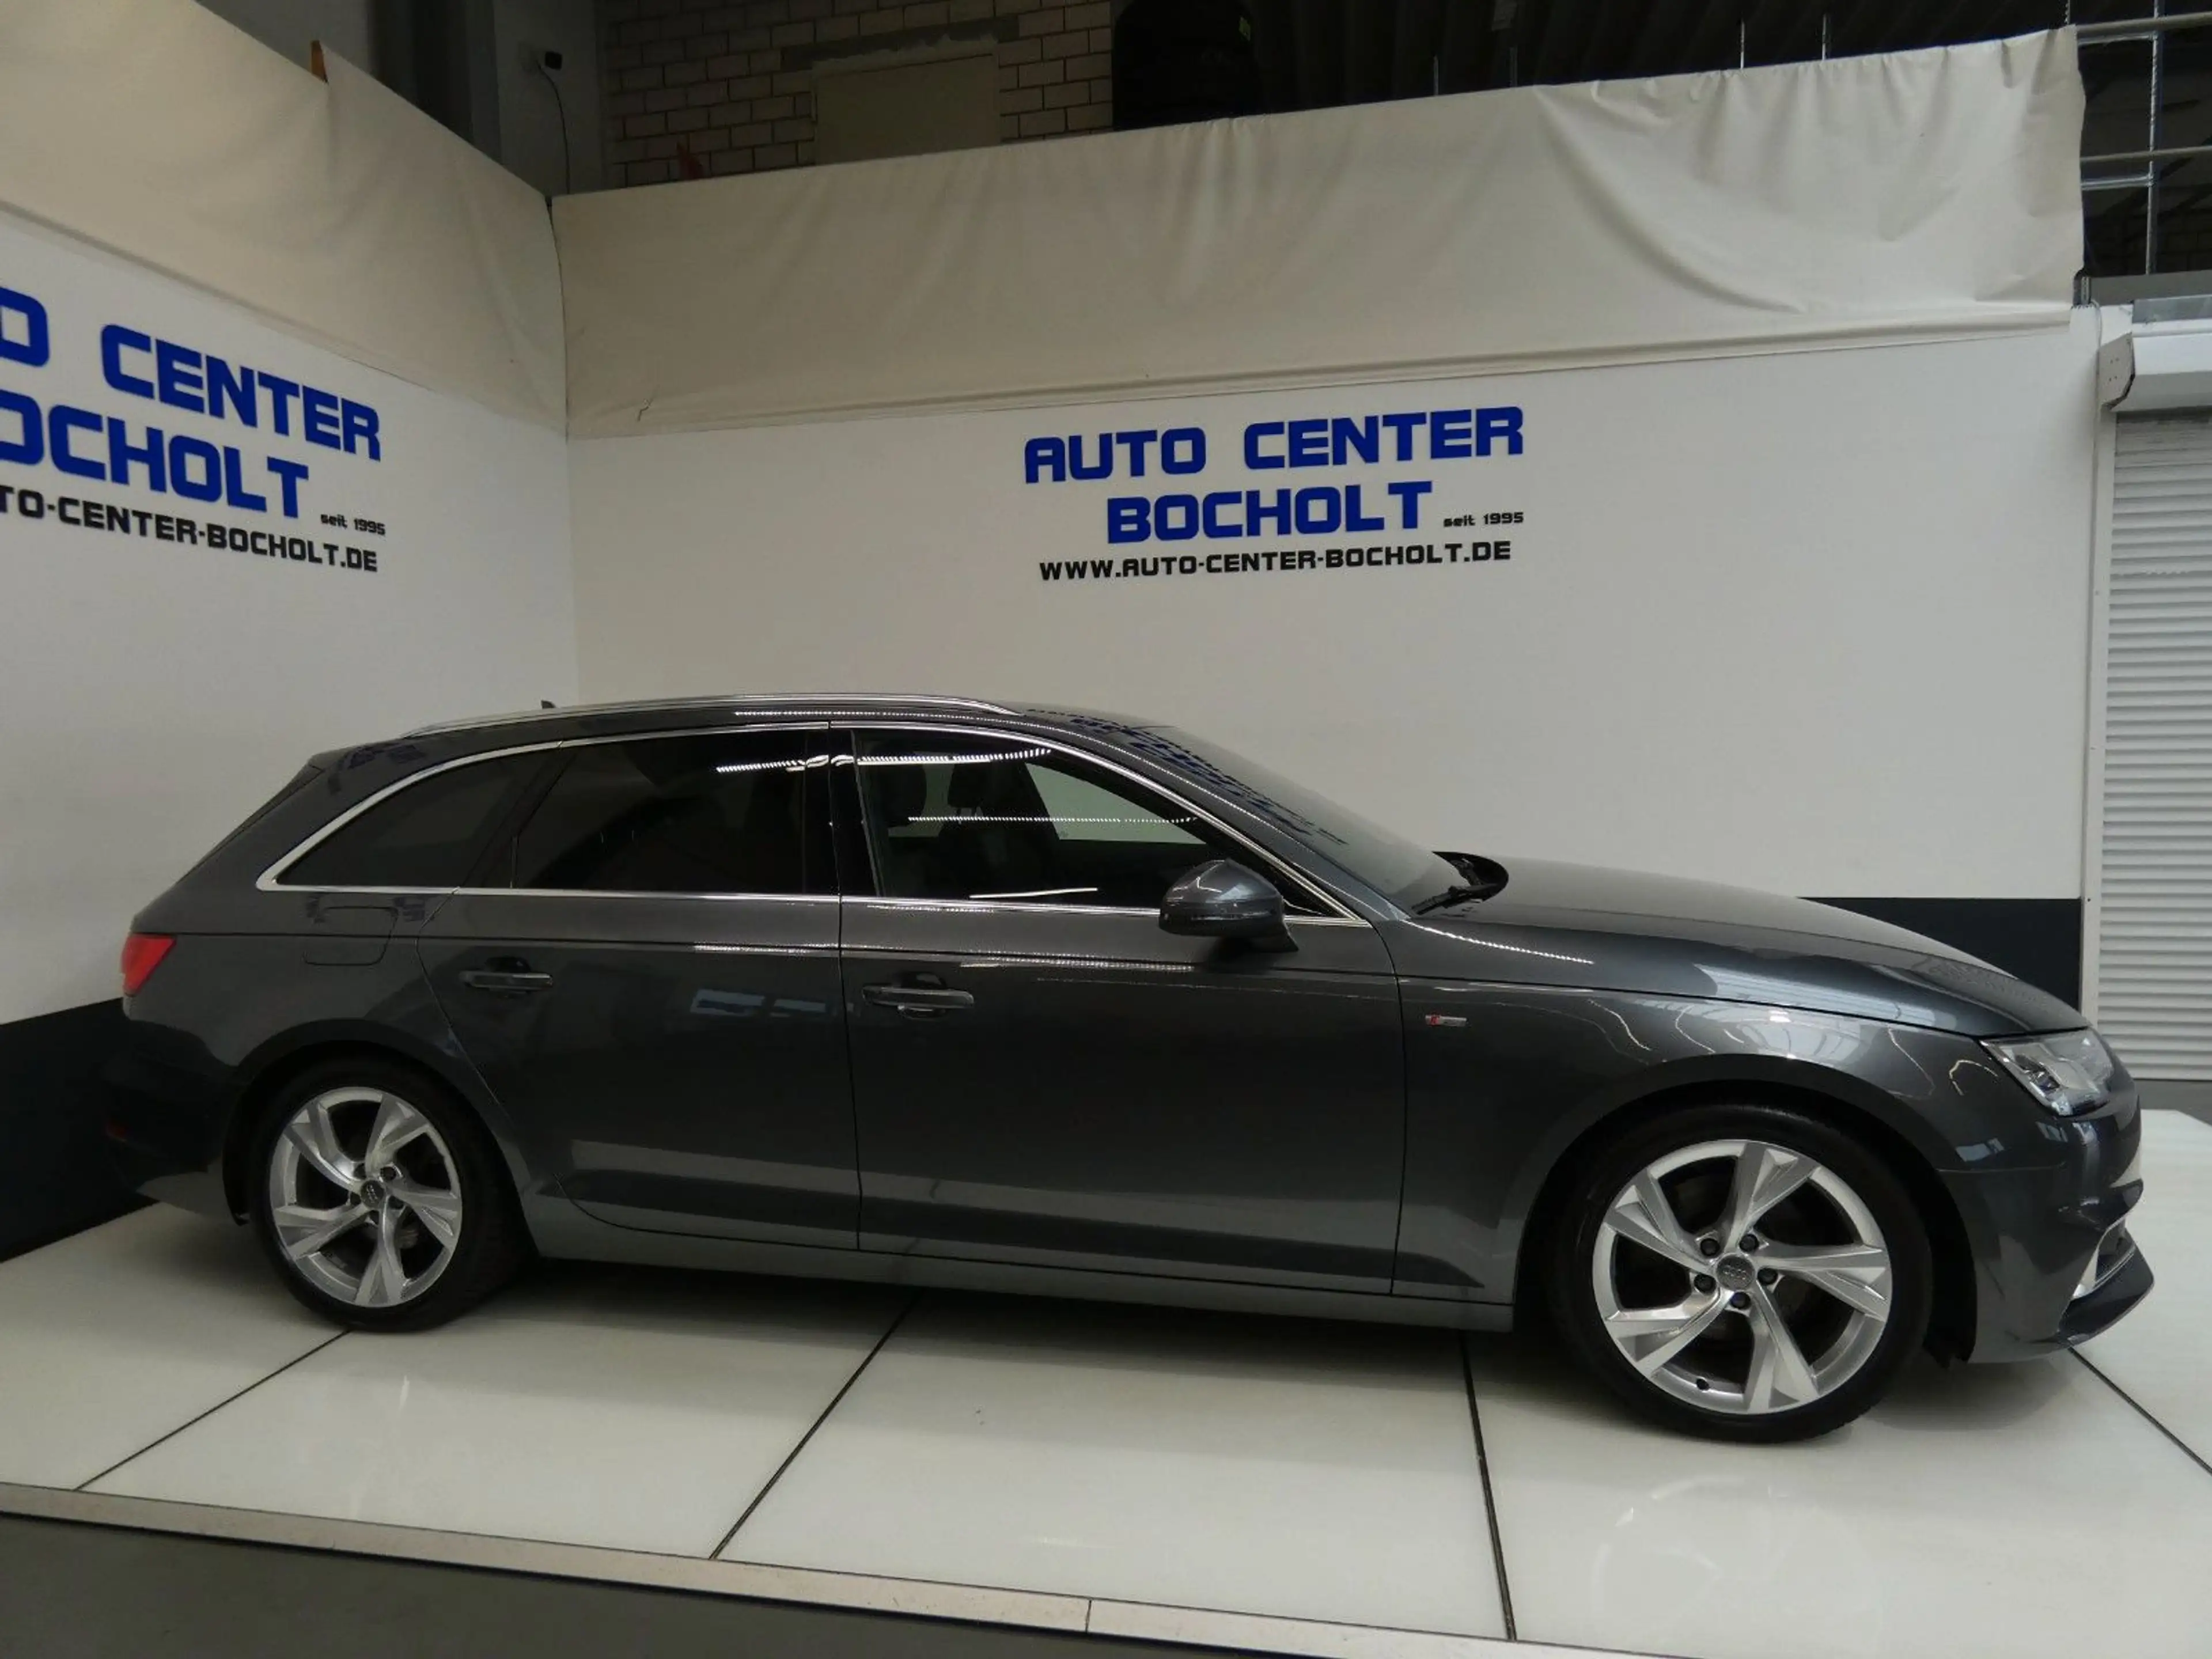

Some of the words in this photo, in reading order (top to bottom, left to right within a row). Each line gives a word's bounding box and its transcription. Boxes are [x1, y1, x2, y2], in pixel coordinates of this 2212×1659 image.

[101, 325, 381, 461] CENTER
[1025, 428, 1206, 483] AUTO
[1244, 406, 1524, 469] CENTER
[320, 514, 348, 529] seit
[353, 518, 385, 536] 1995
[1108, 481, 1433, 544] BOCHOLT
[1443, 514, 1476, 528] seit
[1483, 512, 1524, 525] 1995
[1039, 540, 1511, 581] WWW.AUTO-CENTER-BOCHOLT.DE
